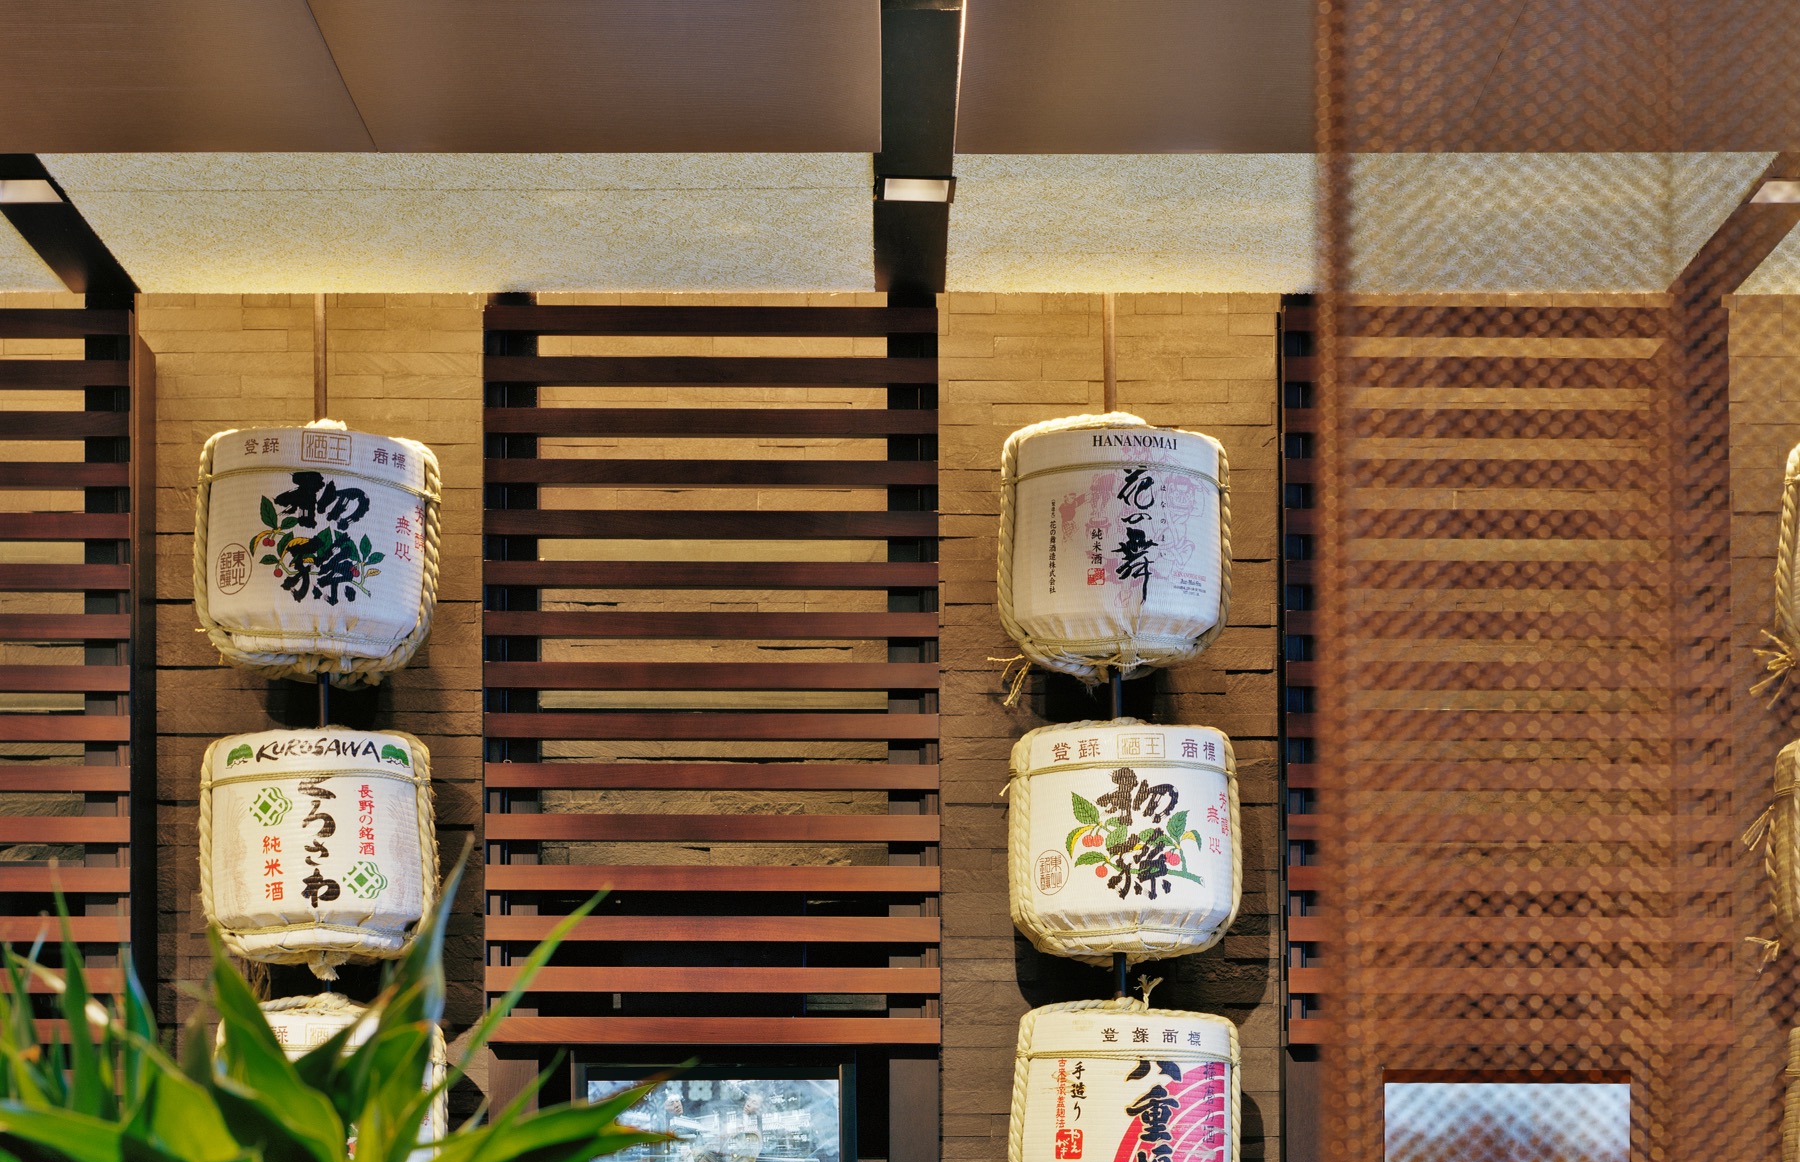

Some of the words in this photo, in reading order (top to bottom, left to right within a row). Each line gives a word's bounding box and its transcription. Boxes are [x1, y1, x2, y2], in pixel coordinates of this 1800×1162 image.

[1092, 435, 1178, 450] HANANOMAI
[1091, 528, 1103, 565] 純米酒
[255, 737, 381, 763] KUROSAWA
[297, 777, 341, 908] くろさわ
[358, 784, 375, 856] 長野の銘酒
[262, 835, 284, 901] 純米酒
[1071, 1061, 1087, 1121] 手造り
